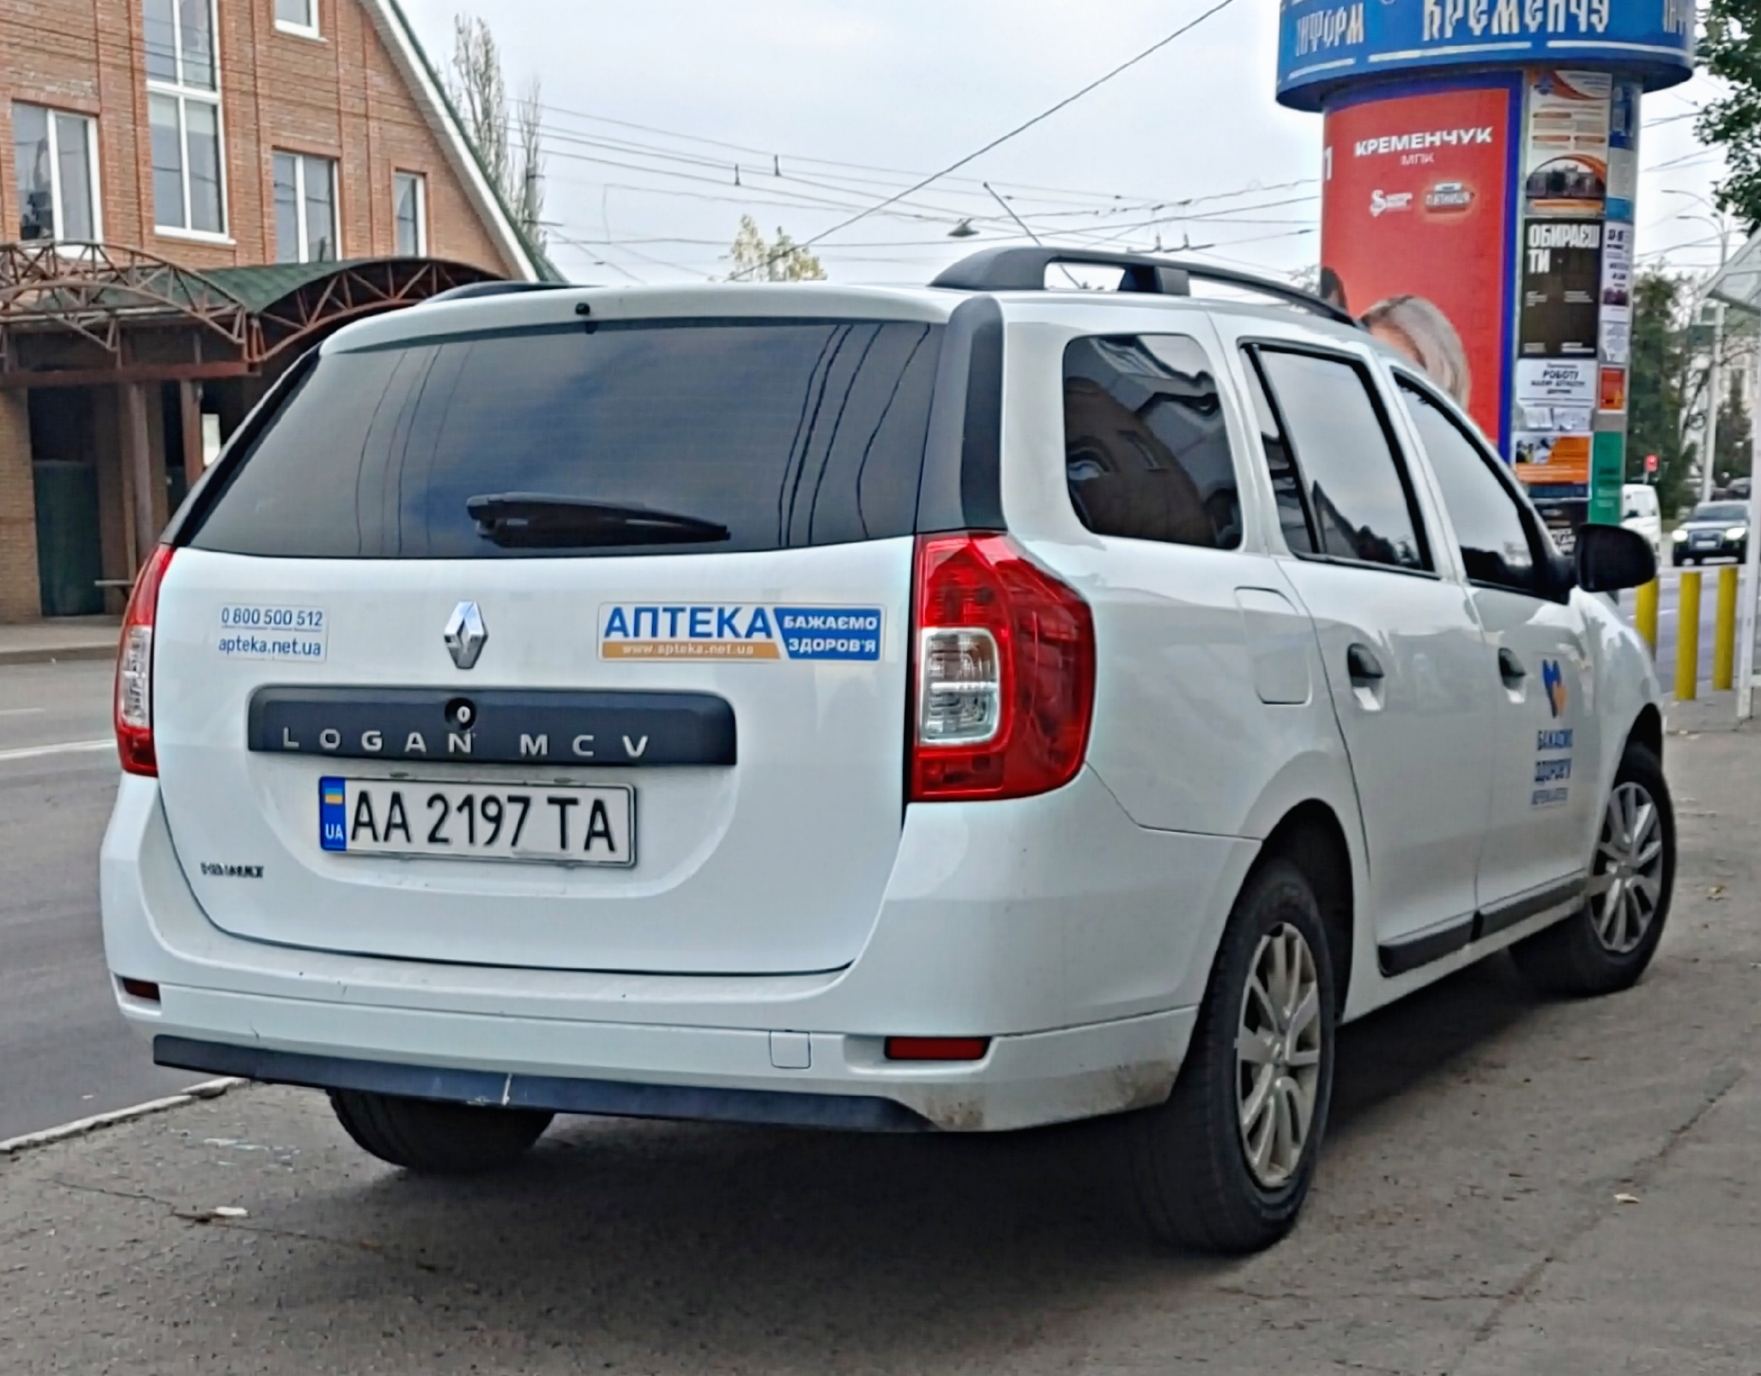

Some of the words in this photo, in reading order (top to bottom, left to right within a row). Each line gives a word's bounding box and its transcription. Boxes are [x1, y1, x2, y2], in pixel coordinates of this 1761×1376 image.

[1354, 126, 1493, 157] КРЕМЕНЧУК
[1528, 249, 1551, 274] ТИ
[221, 607, 230, 624] 0
[233, 608, 261, 625] 800
[264, 609, 293, 626] 500
[297, 610, 323, 627] 512
[604, 606, 773, 639] АПТЕКА
[783, 615, 878, 630] БАЖАЄМО
[218, 635, 322, 657] apteka.net.ua
[622, 643, 754, 656] www.apteka.net.ua
[788, 637, 876, 653] ЗДОРОВ'Я
[283, 727, 472, 753] LOGAN
[520, 734, 648, 757] MCV
[324, 823, 344, 840] UA
[351, 790, 412, 842] AA
[426, 793, 532, 847] 2197
[547, 796, 617, 853] TA
